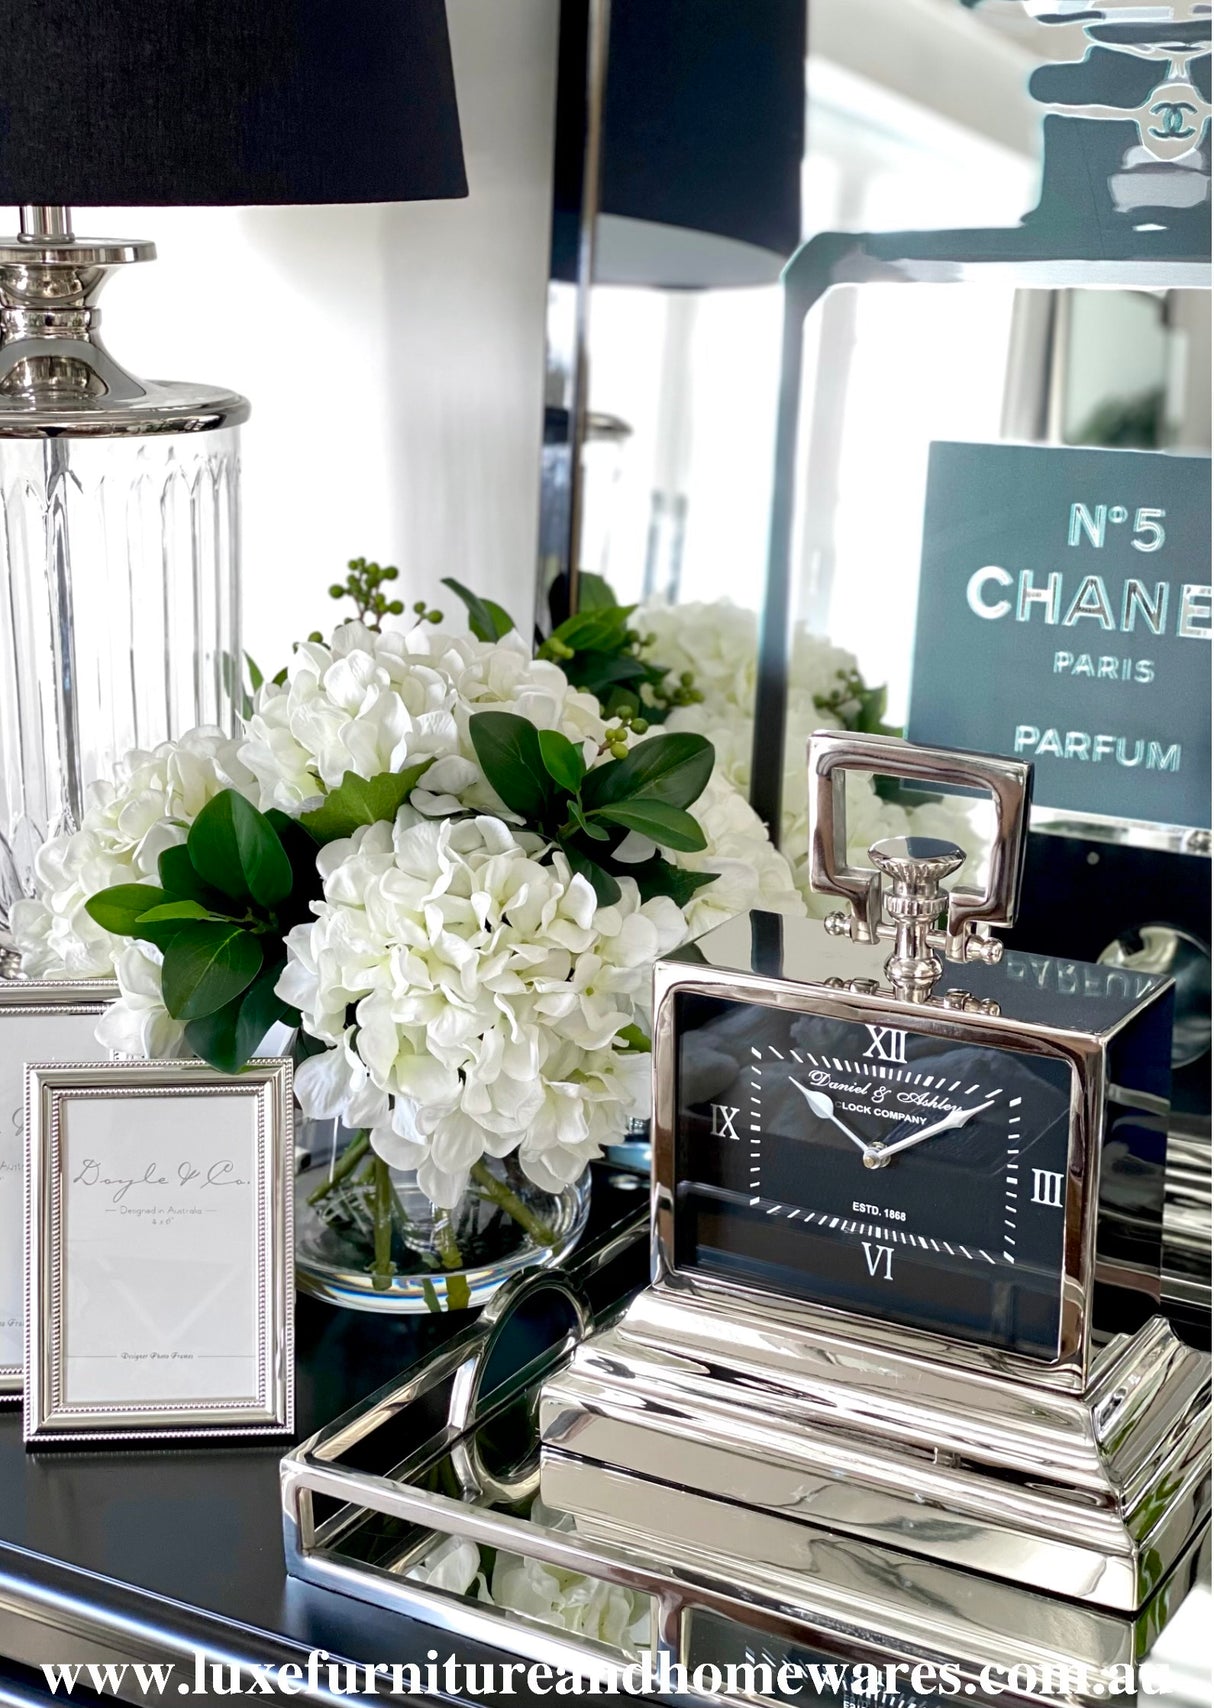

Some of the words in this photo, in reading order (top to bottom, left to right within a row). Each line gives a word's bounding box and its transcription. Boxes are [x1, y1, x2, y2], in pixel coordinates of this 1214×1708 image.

[1053, 650, 1156, 684] PARIS
[1013, 724, 1182, 773] PARFUM
[862, 1023, 908, 1065] XII
[808, 1069, 872, 1096] Daniel
[872, 1085, 892, 1104] &
[709, 1103, 741, 1141] IX
[873, 1108, 927, 1126] COMPANY
[73, 1158, 169, 1204] Doyle
[200, 1159, 251, 1190] Co.
[1030, 1168, 1065, 1209] III
[120, 1205, 156, 1218] Designed
[157, 1206, 165, 1215] in
[168, 1205, 203, 1216] Australia
[852, 1201, 881, 1217] ESTD.
[884, 1206, 907, 1223] 1868
[860, 1241, 895, 1281] VI
[120, 1351, 148, 1362] Designer
[150, 1351, 170, 1360] Photo
